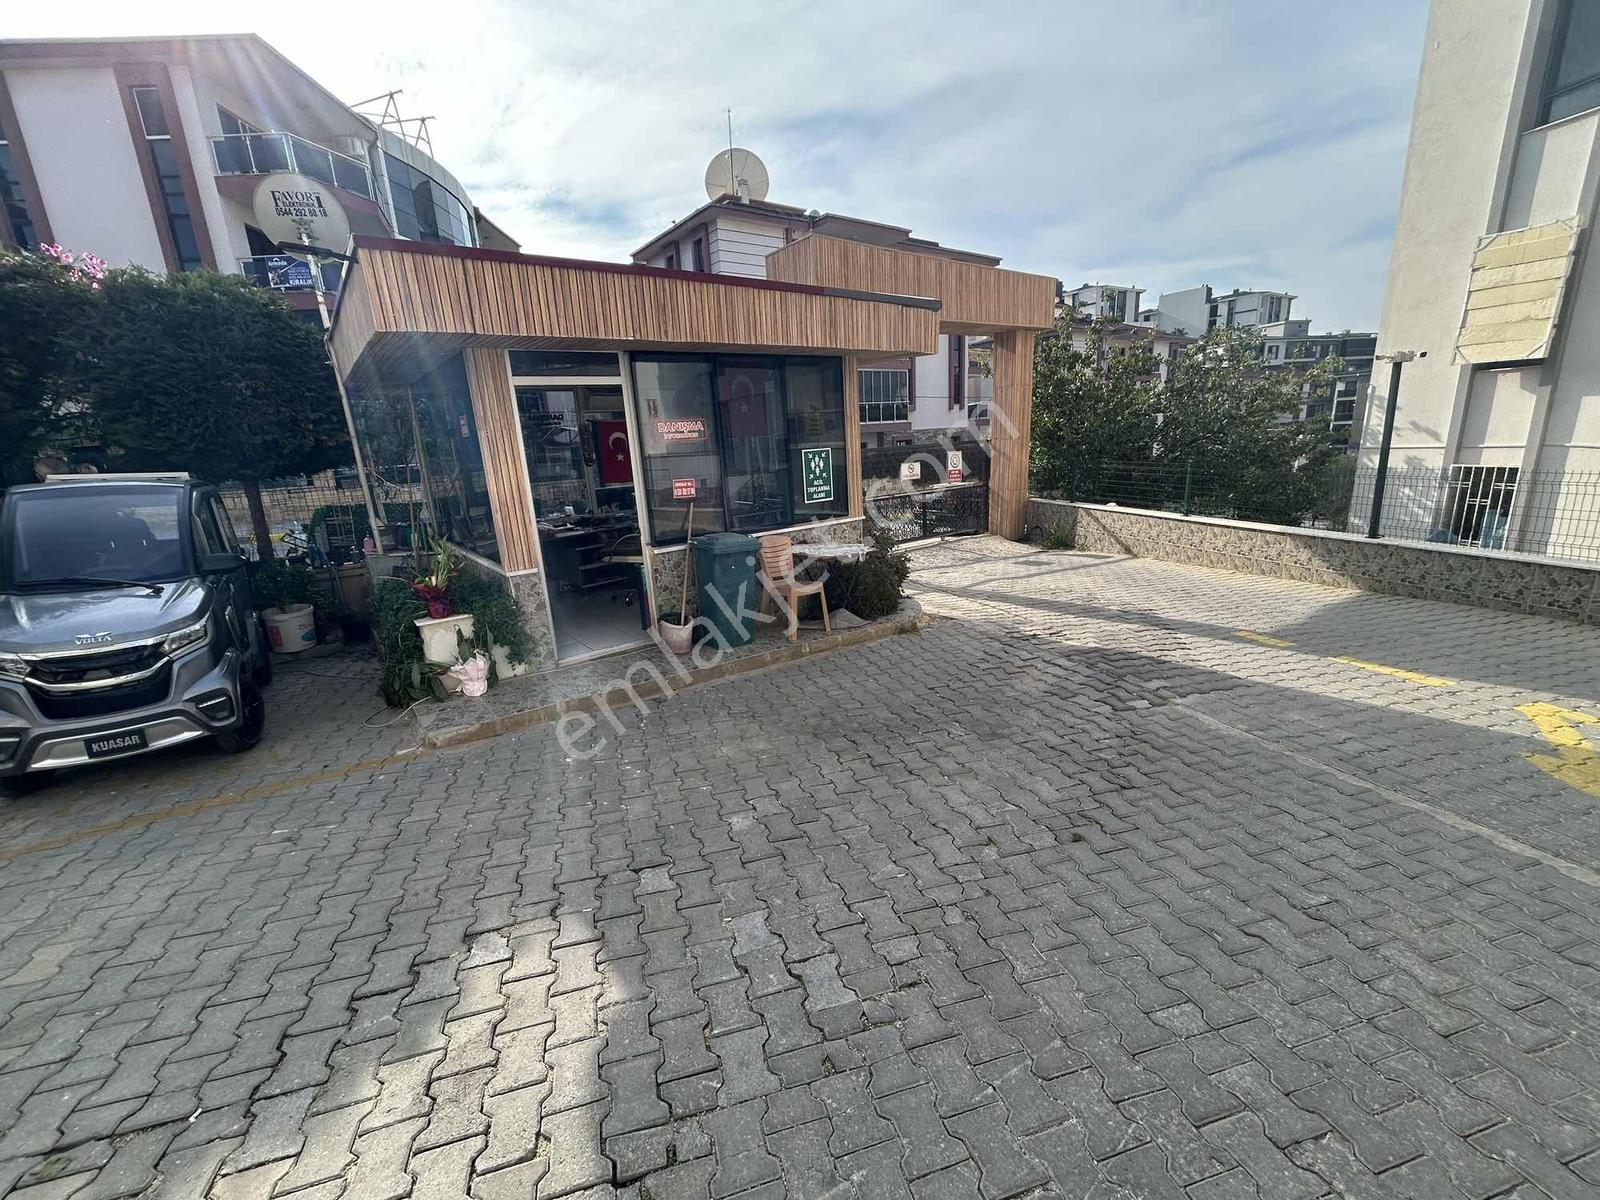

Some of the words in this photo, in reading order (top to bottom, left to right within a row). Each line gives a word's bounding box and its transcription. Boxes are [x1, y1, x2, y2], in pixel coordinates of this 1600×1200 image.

[275, 207, 293, 216] 0544
[293, 207, 307, 216] 292
[75, 635, 112, 645] VOLTA
[92, 735, 140, 752] KUASAR
